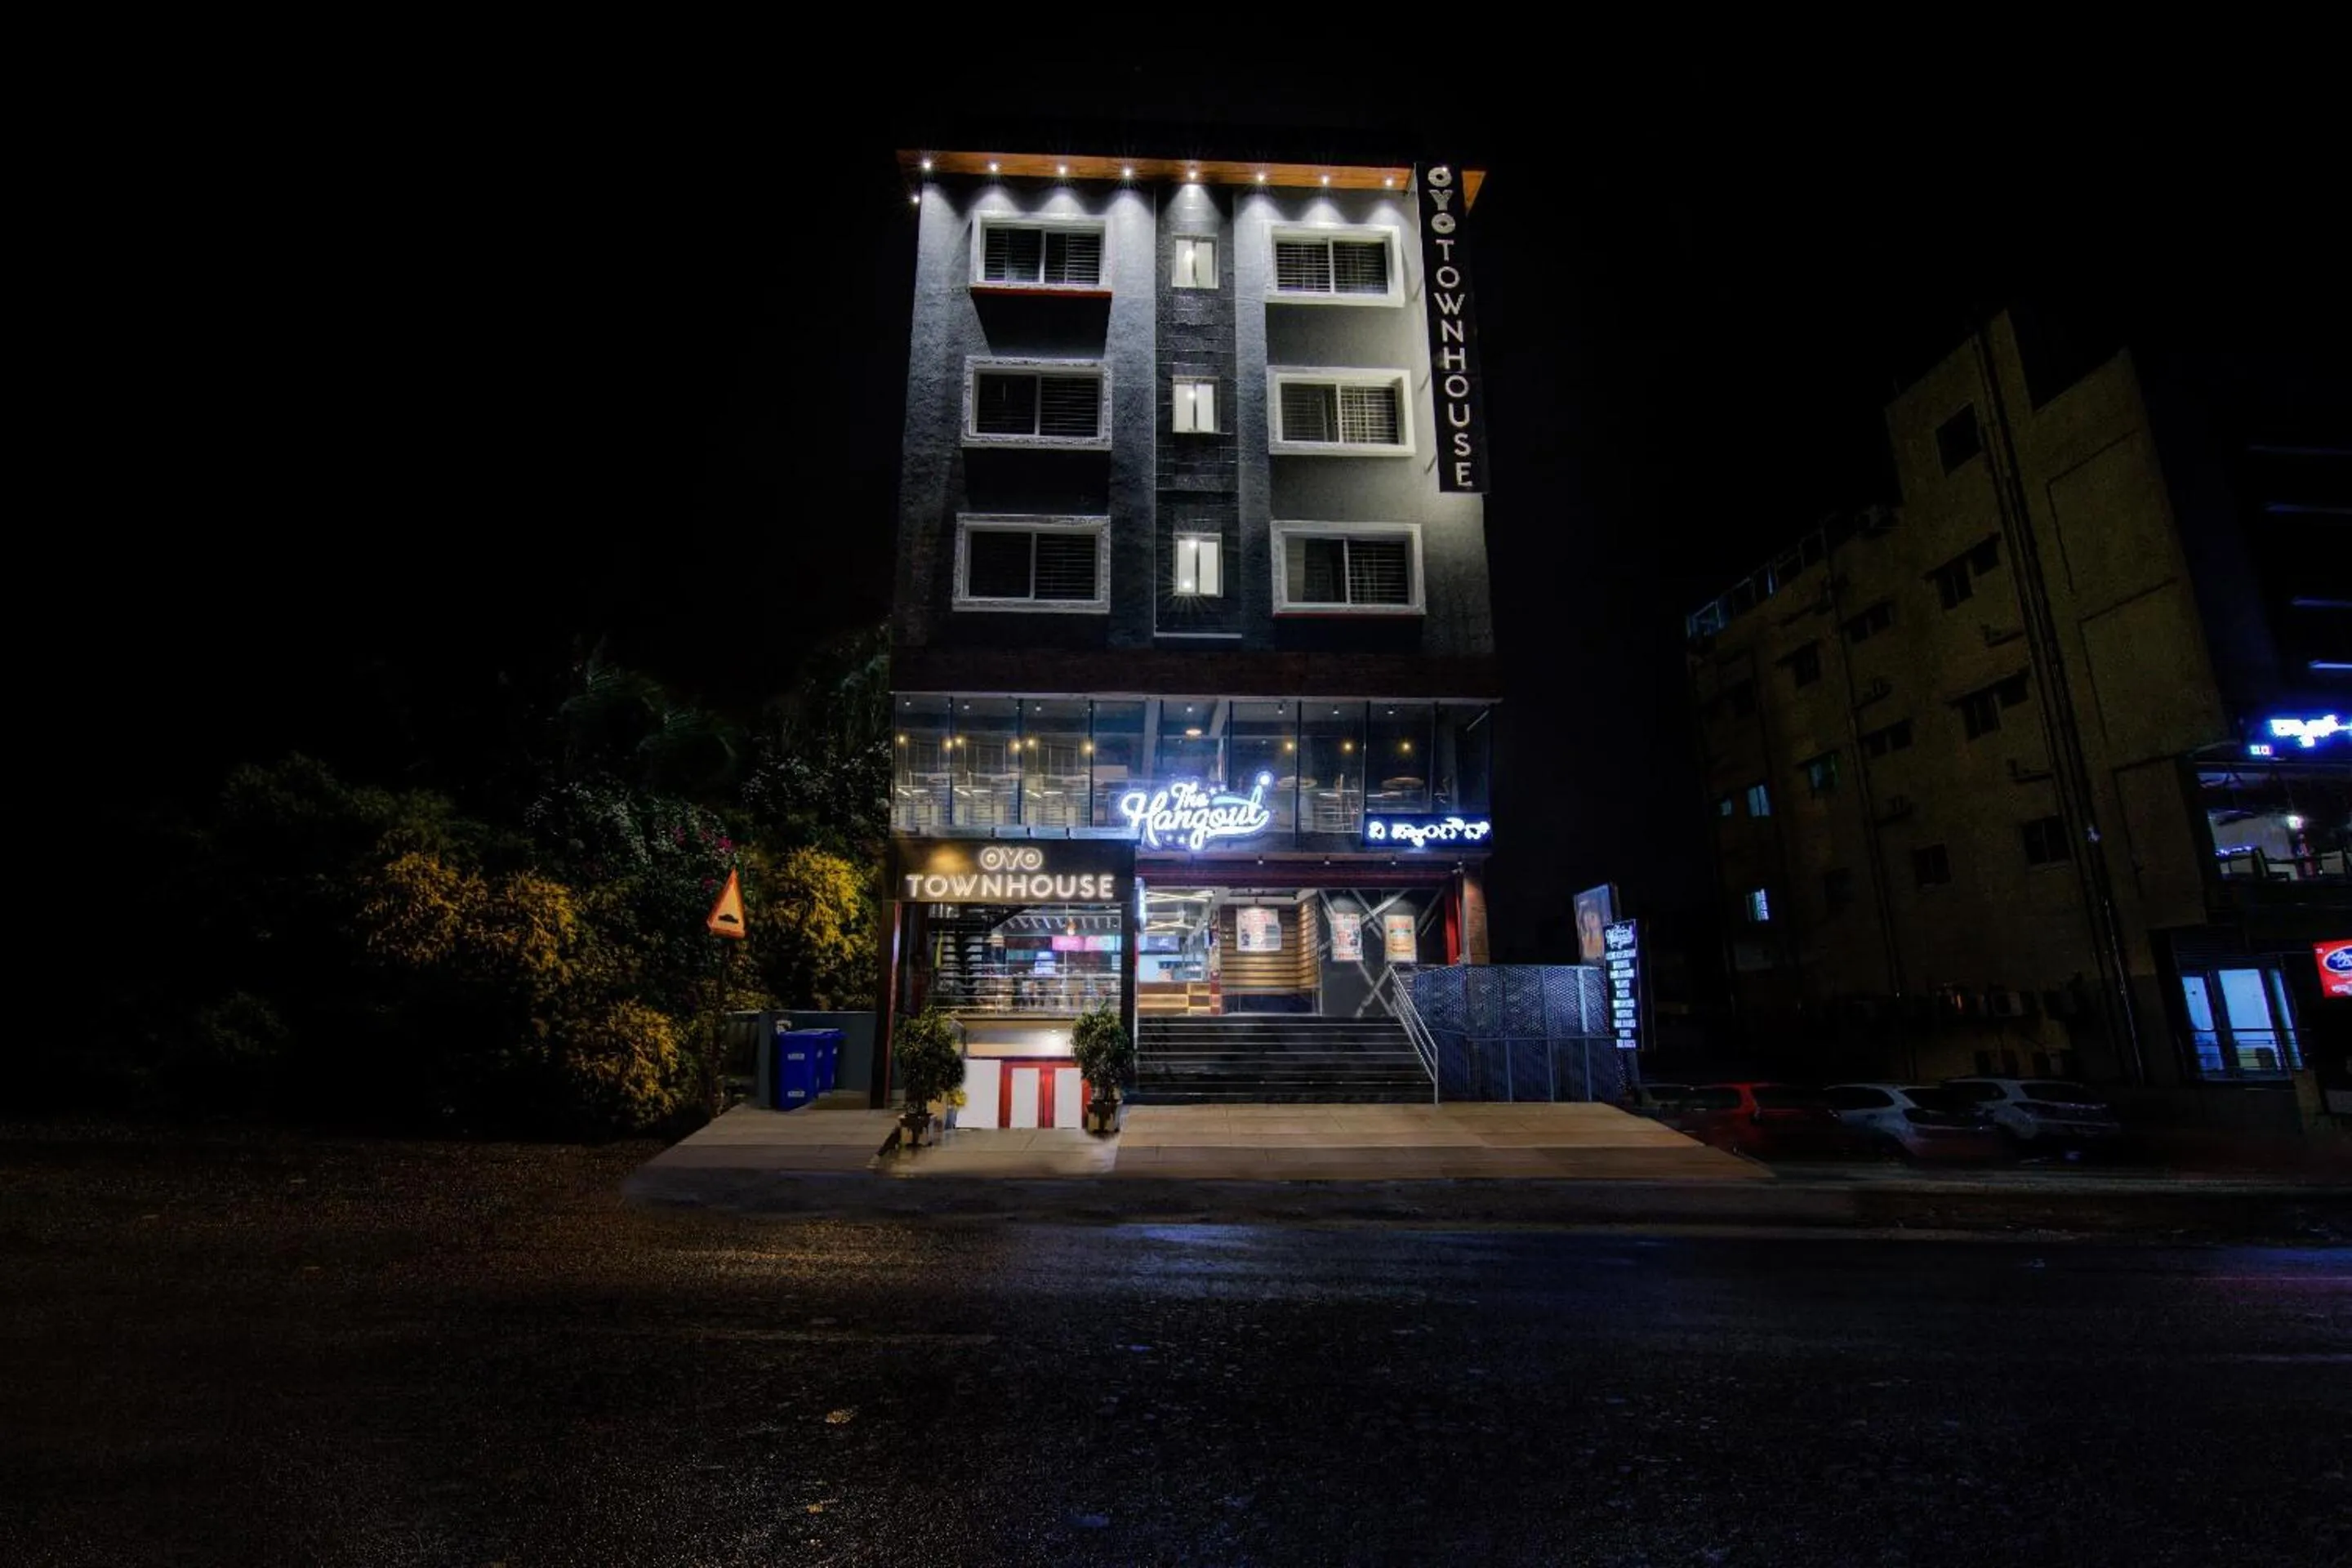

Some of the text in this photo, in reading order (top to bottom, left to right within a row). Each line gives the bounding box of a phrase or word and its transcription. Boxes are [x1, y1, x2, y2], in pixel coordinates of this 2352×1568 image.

[1427, 166, 1473, 488] OYO TOWNHOUSE
[1170, 781, 1209, 811] The
[1120, 783, 1271, 850] Hangout
[979, 845, 1044, 871] OYO
[904, 873, 1116, 899] TOWNHOUSE
